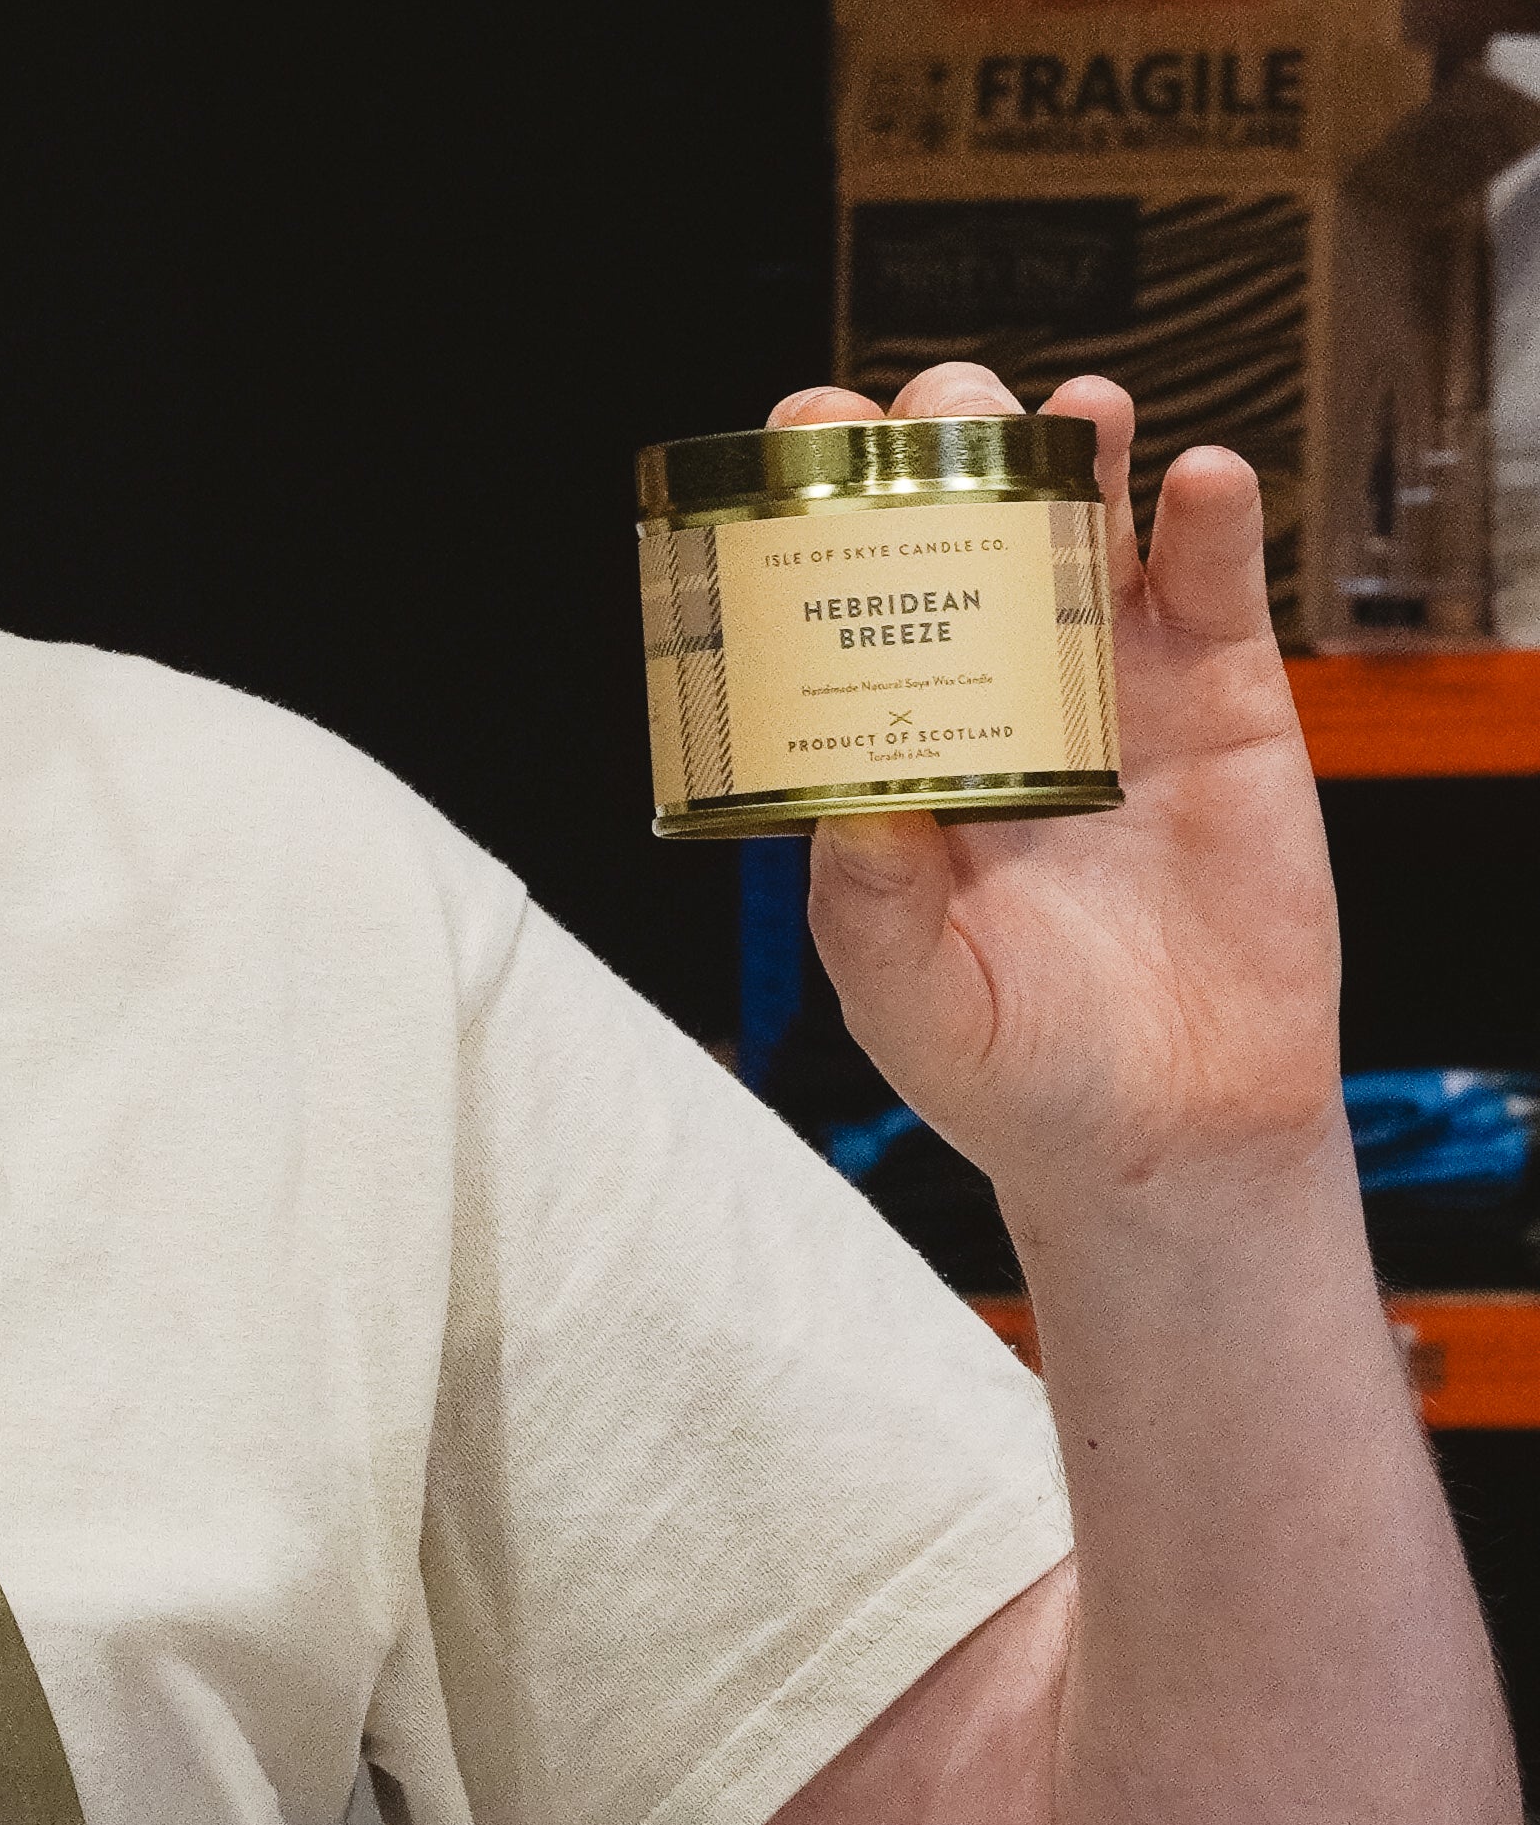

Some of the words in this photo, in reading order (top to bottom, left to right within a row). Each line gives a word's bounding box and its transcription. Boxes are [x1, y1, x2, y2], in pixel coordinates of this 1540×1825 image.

[974, 48, 1306, 120] FRAGILE
[764, 552, 802, 568] ISLE
[810, 549, 835, 564] OF
[842, 544, 891, 561] SKYE
[898, 539, 973, 556] CANDLE
[980, 538, 1009, 552] CO.
[803, 589, 982, 622] HEBRIDEAN
[839, 621, 952, 650] BREEZE
[787, 733, 876, 752] PRODUCT
[885, 730, 910, 745] OF
[918, 725, 1014, 742] SCOTLAND
